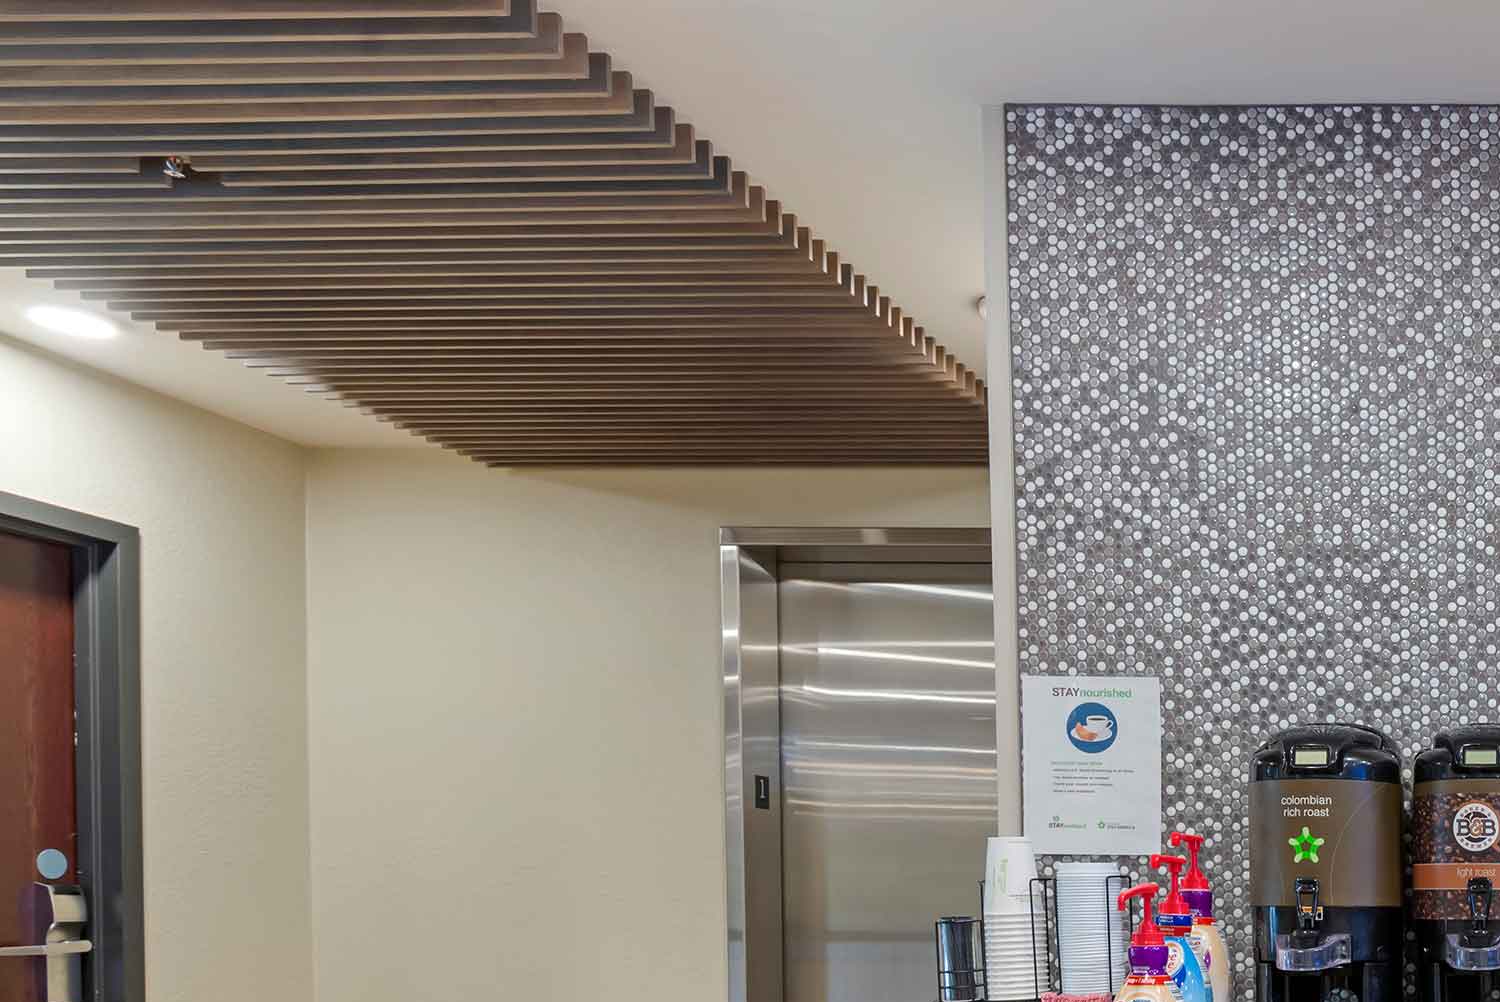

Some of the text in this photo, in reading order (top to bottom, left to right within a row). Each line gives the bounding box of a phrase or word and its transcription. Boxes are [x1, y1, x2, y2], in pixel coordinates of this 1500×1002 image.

[1281, 795, 1332, 805] colombian
[1283, 806, 1329, 817] rich roast
